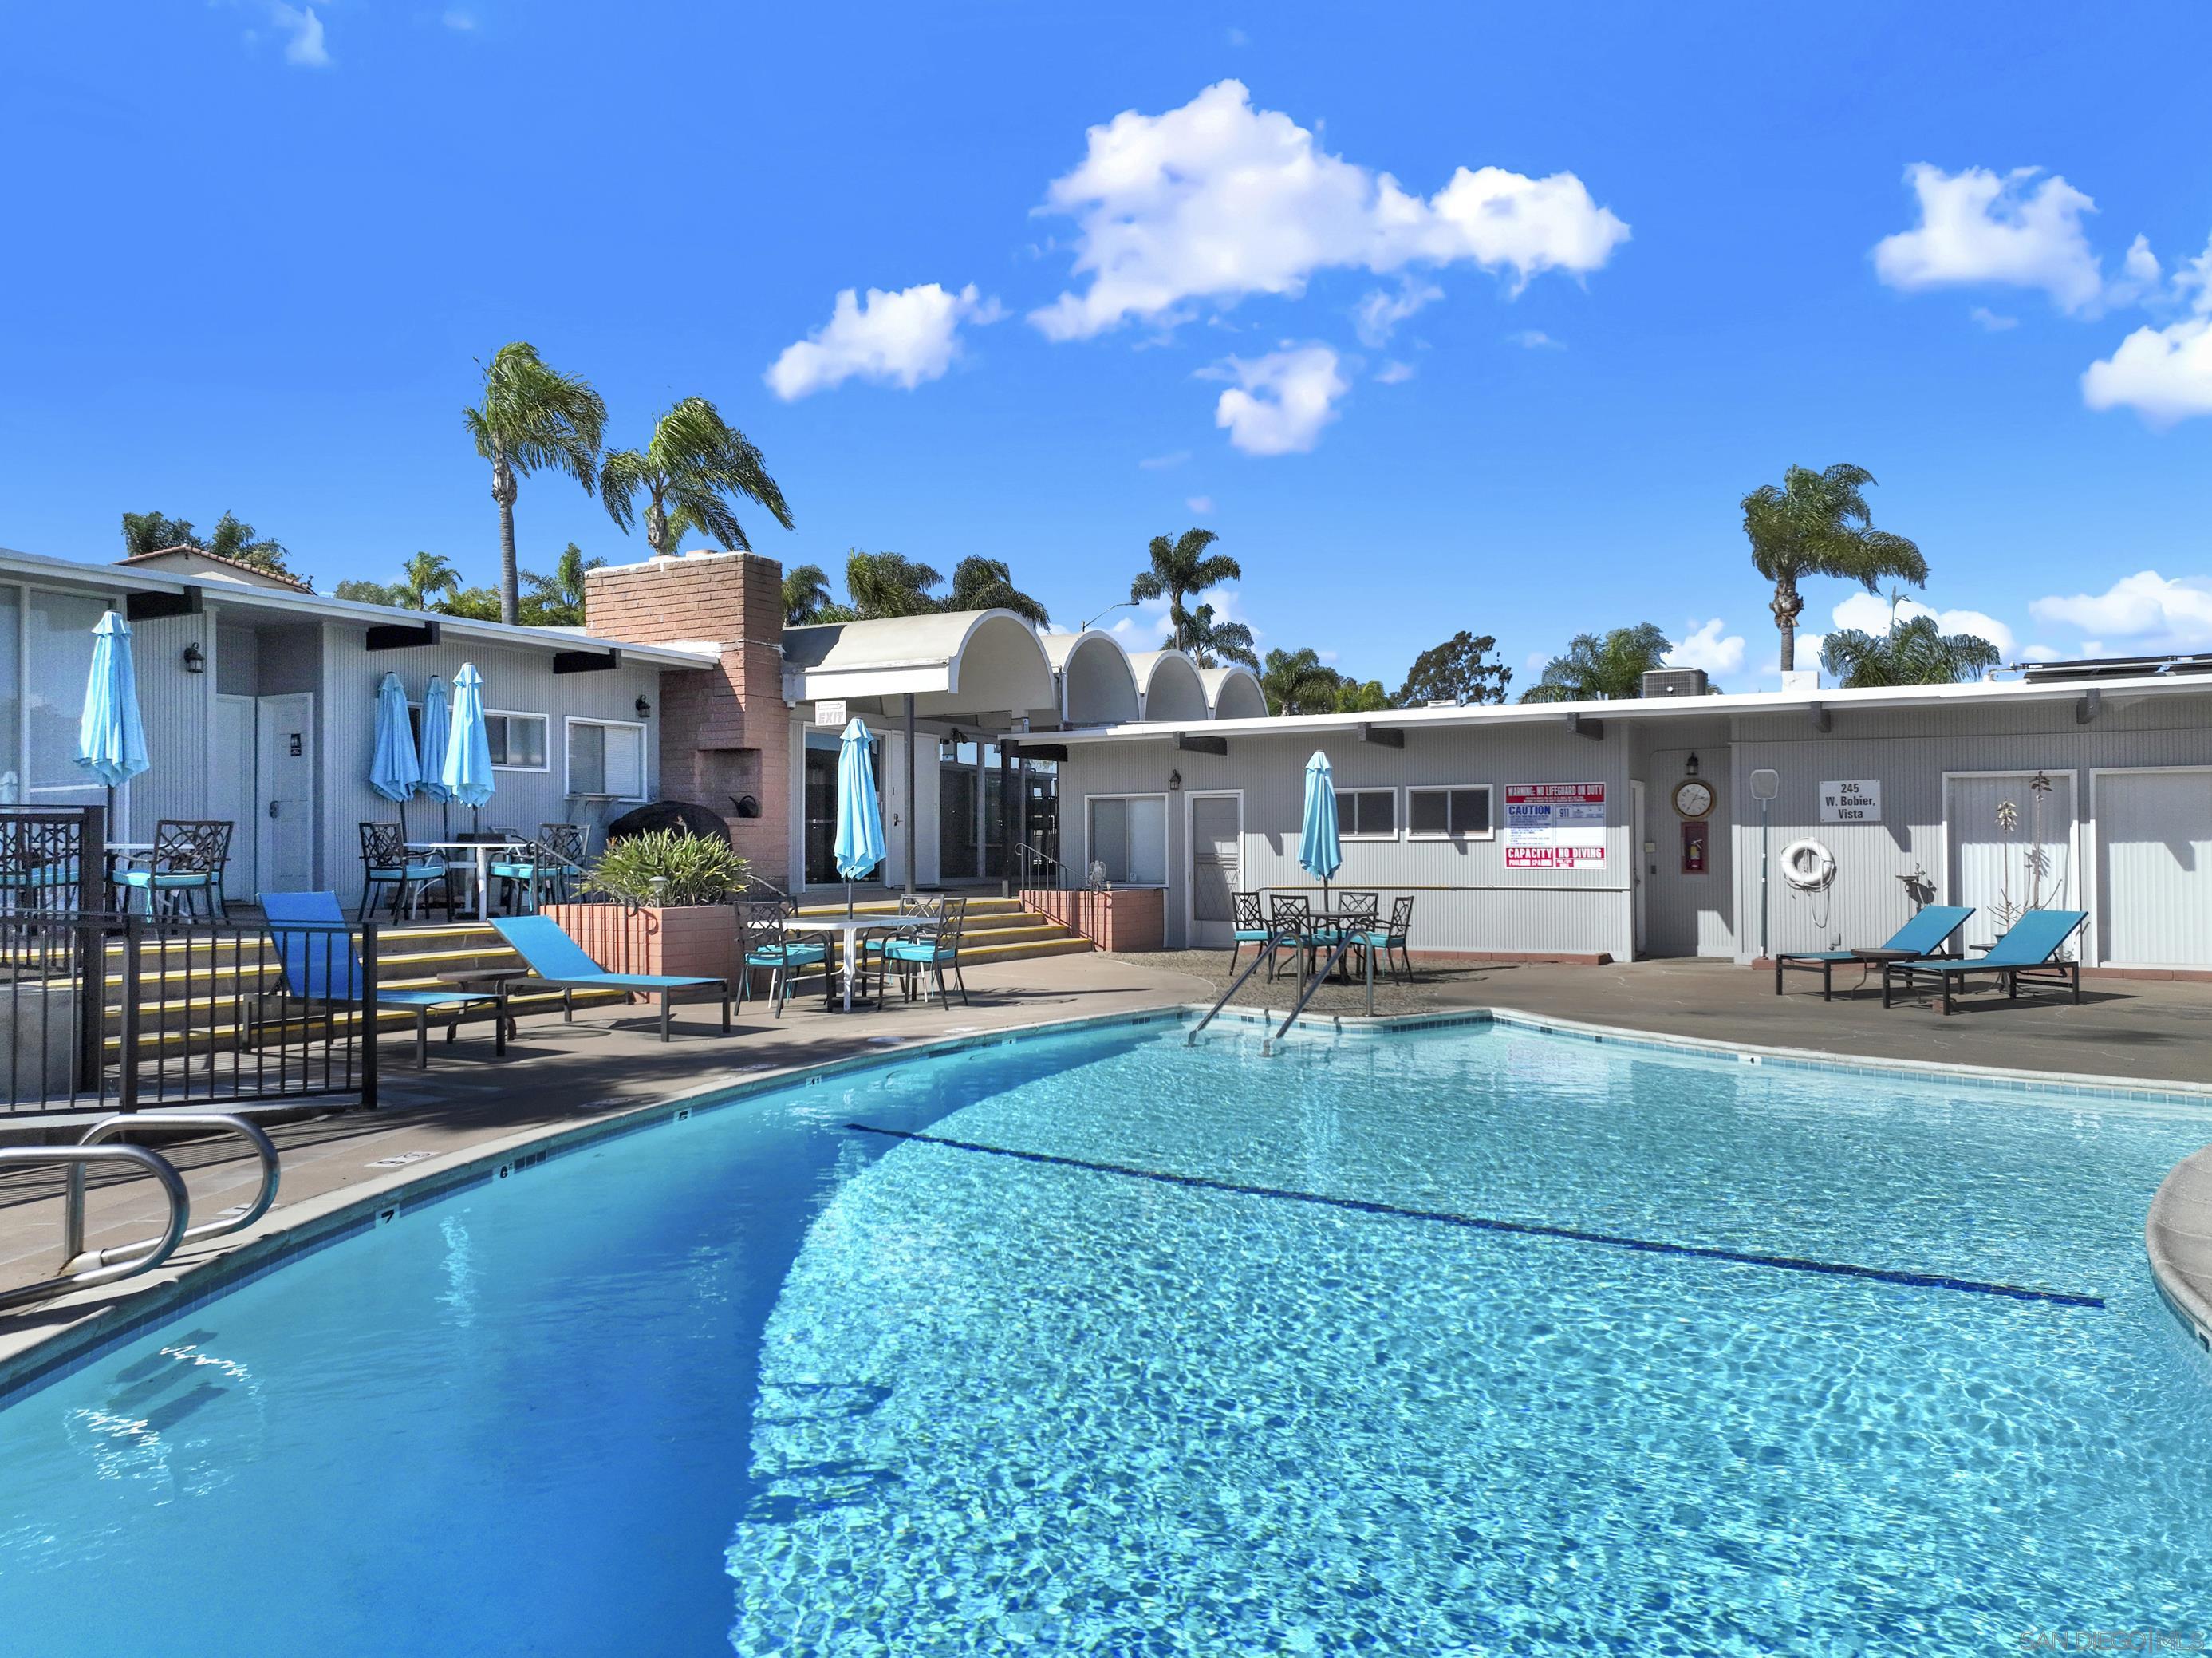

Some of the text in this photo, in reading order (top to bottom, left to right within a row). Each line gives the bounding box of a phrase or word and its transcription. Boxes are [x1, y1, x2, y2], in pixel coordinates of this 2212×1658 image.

[818, 712, 843, 724] EXIT
[1508, 784, 1603, 796] WARNING: NO LIFEGUARD ON DUTY
[1841, 784, 1859, 794] 245
[1825, 795, 1875, 807] W. Bobier,
[1508, 805, 1551, 815] CAUTION
[1559, 808, 1569, 818] 911
[1838, 809, 1863, 819] Vista
[1508, 848, 1552, 859] CAPACITY
[1558, 848, 1602, 859] NO DIVING
[500, 1165, 508, 1178] 6
[381, 1209, 395, 1224] 7
